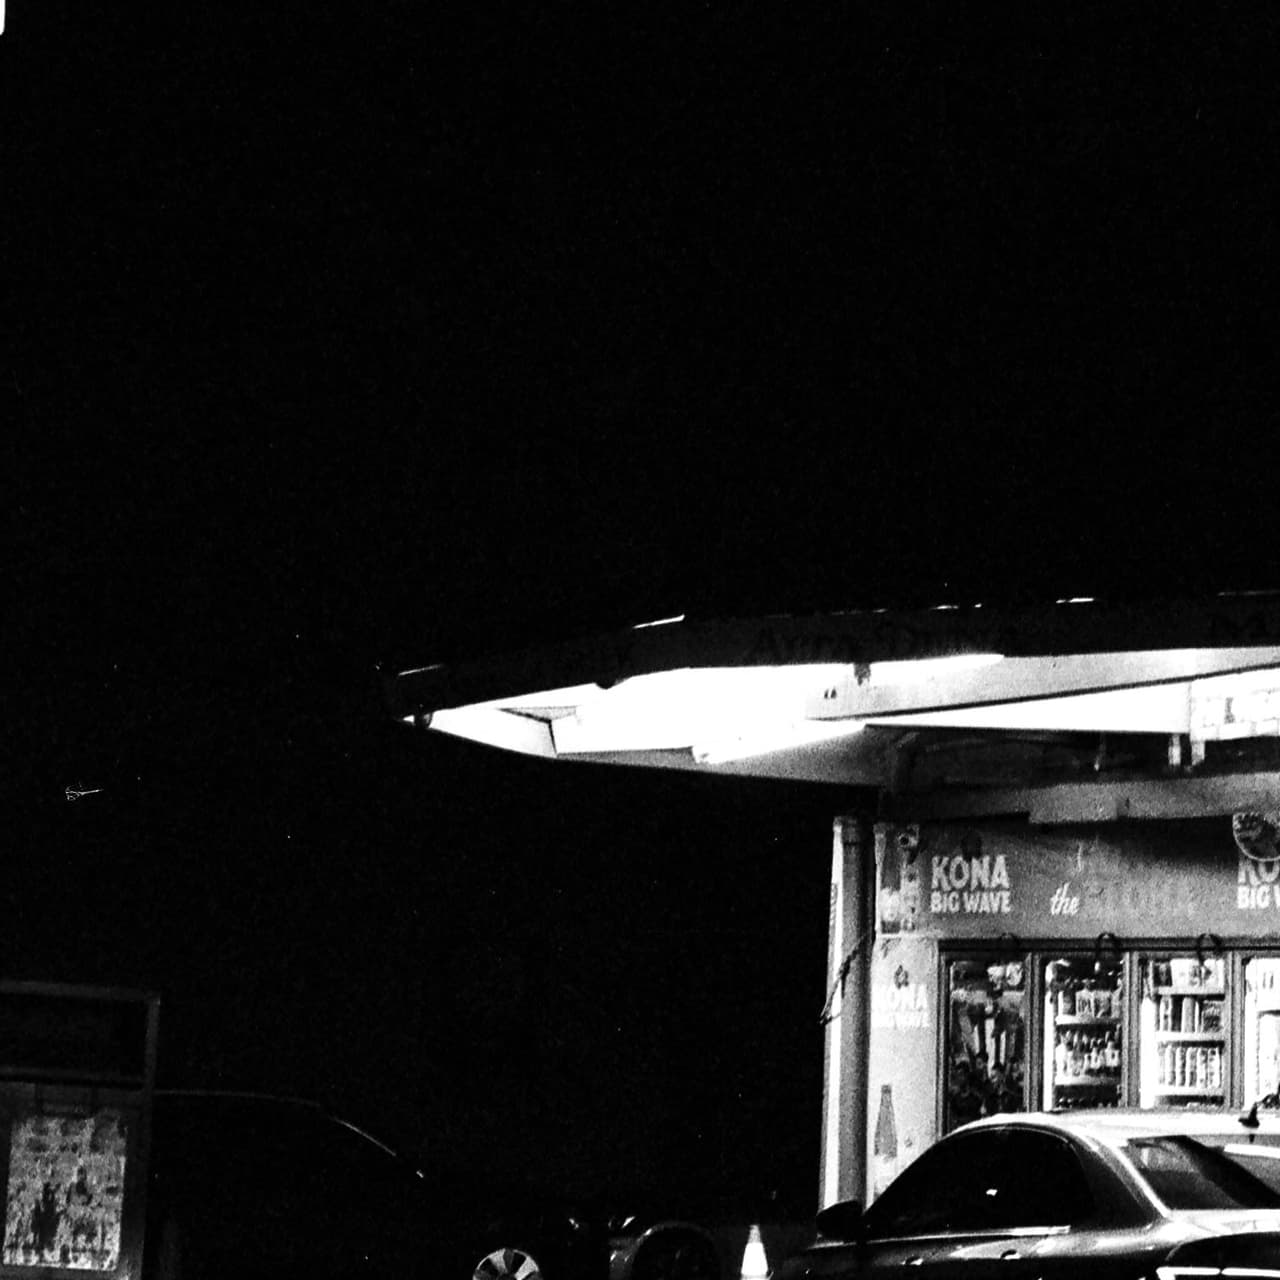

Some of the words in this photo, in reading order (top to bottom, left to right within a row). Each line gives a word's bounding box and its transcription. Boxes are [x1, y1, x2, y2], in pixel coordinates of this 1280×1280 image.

[930, 853, 1011, 891] KONA
[930, 889, 961, 914] BIG
[962, 889, 1012, 914] WAVE
[1049, 880, 1081, 916] the
[1236, 885, 1271, 910] BIG
